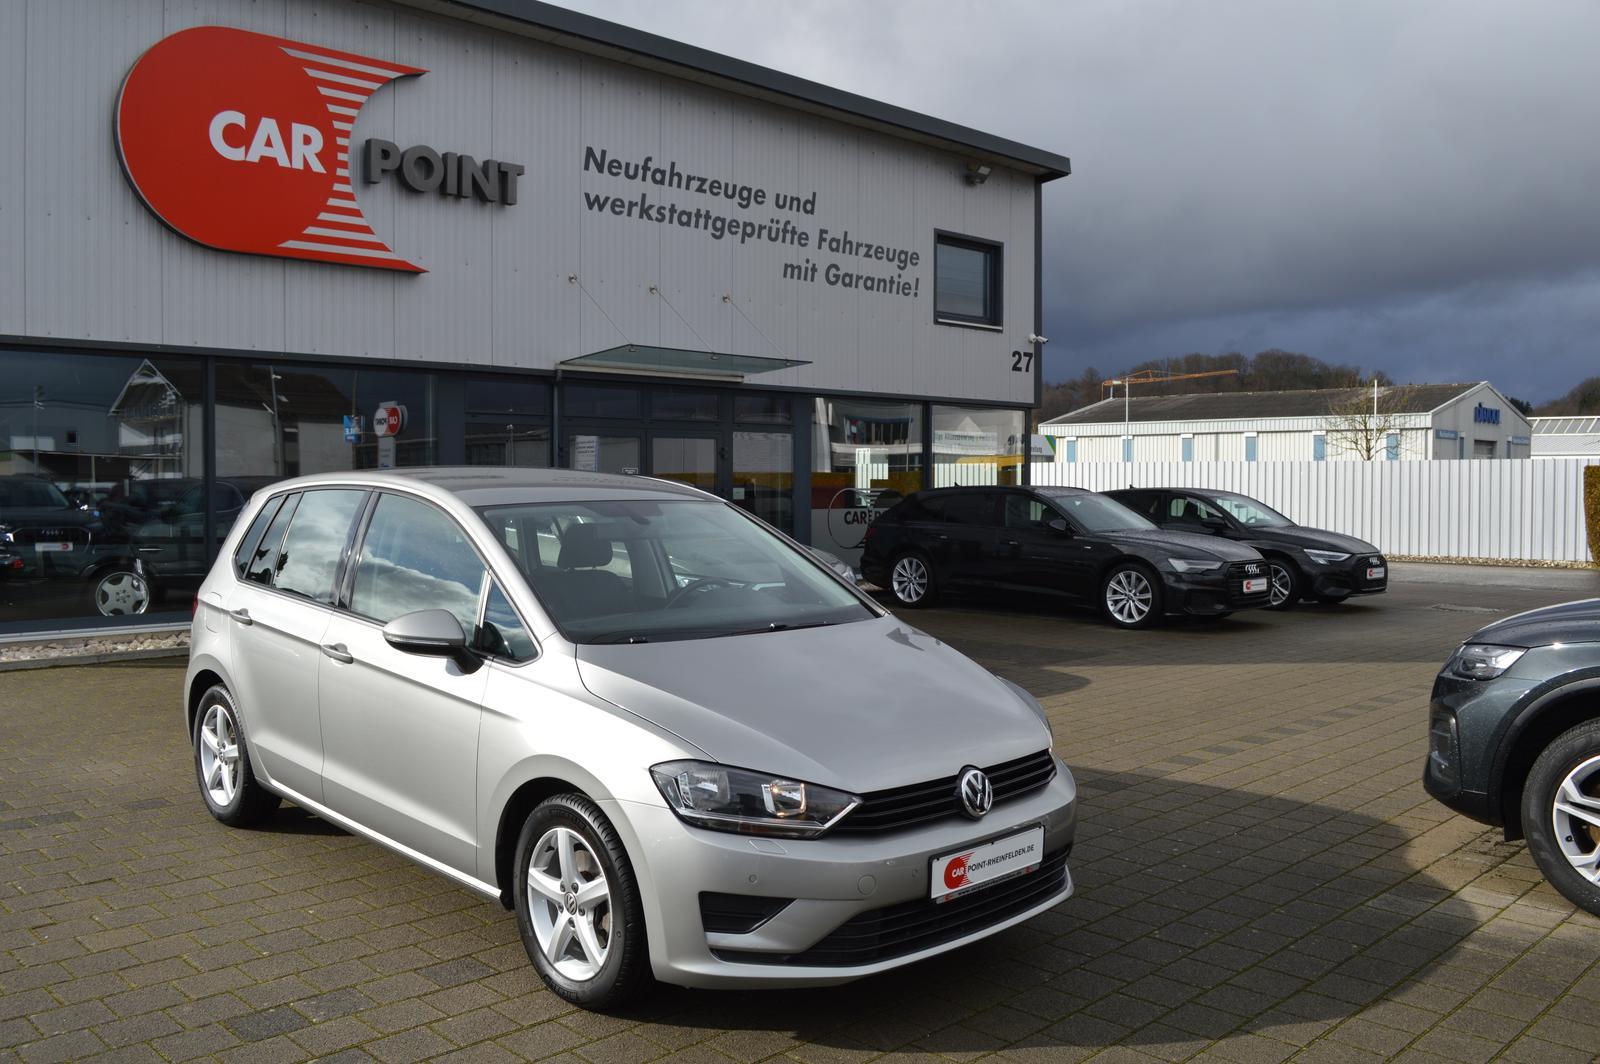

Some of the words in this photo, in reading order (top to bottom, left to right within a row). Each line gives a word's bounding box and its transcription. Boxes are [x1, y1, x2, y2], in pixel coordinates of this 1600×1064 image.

[208, 110, 327, 174] CAR
[364, 138, 525, 206] POINT
[583, 146, 767, 209] Neufahrzeuge
[774, 191, 817, 215] und
[583, 192, 810, 244] werkstattgeprüfte
[817, 228, 920, 271] Fahrzeuge
[782, 259, 818, 283] mit
[824, 264, 920, 298] Garantie!
[1011, 350, 1034, 373] 27
[844, 510, 867, 525] CAR
[951, 867, 965, 878] CAR
[967, 844, 1035, 873] POINT-RHEINFELDEN.DE
